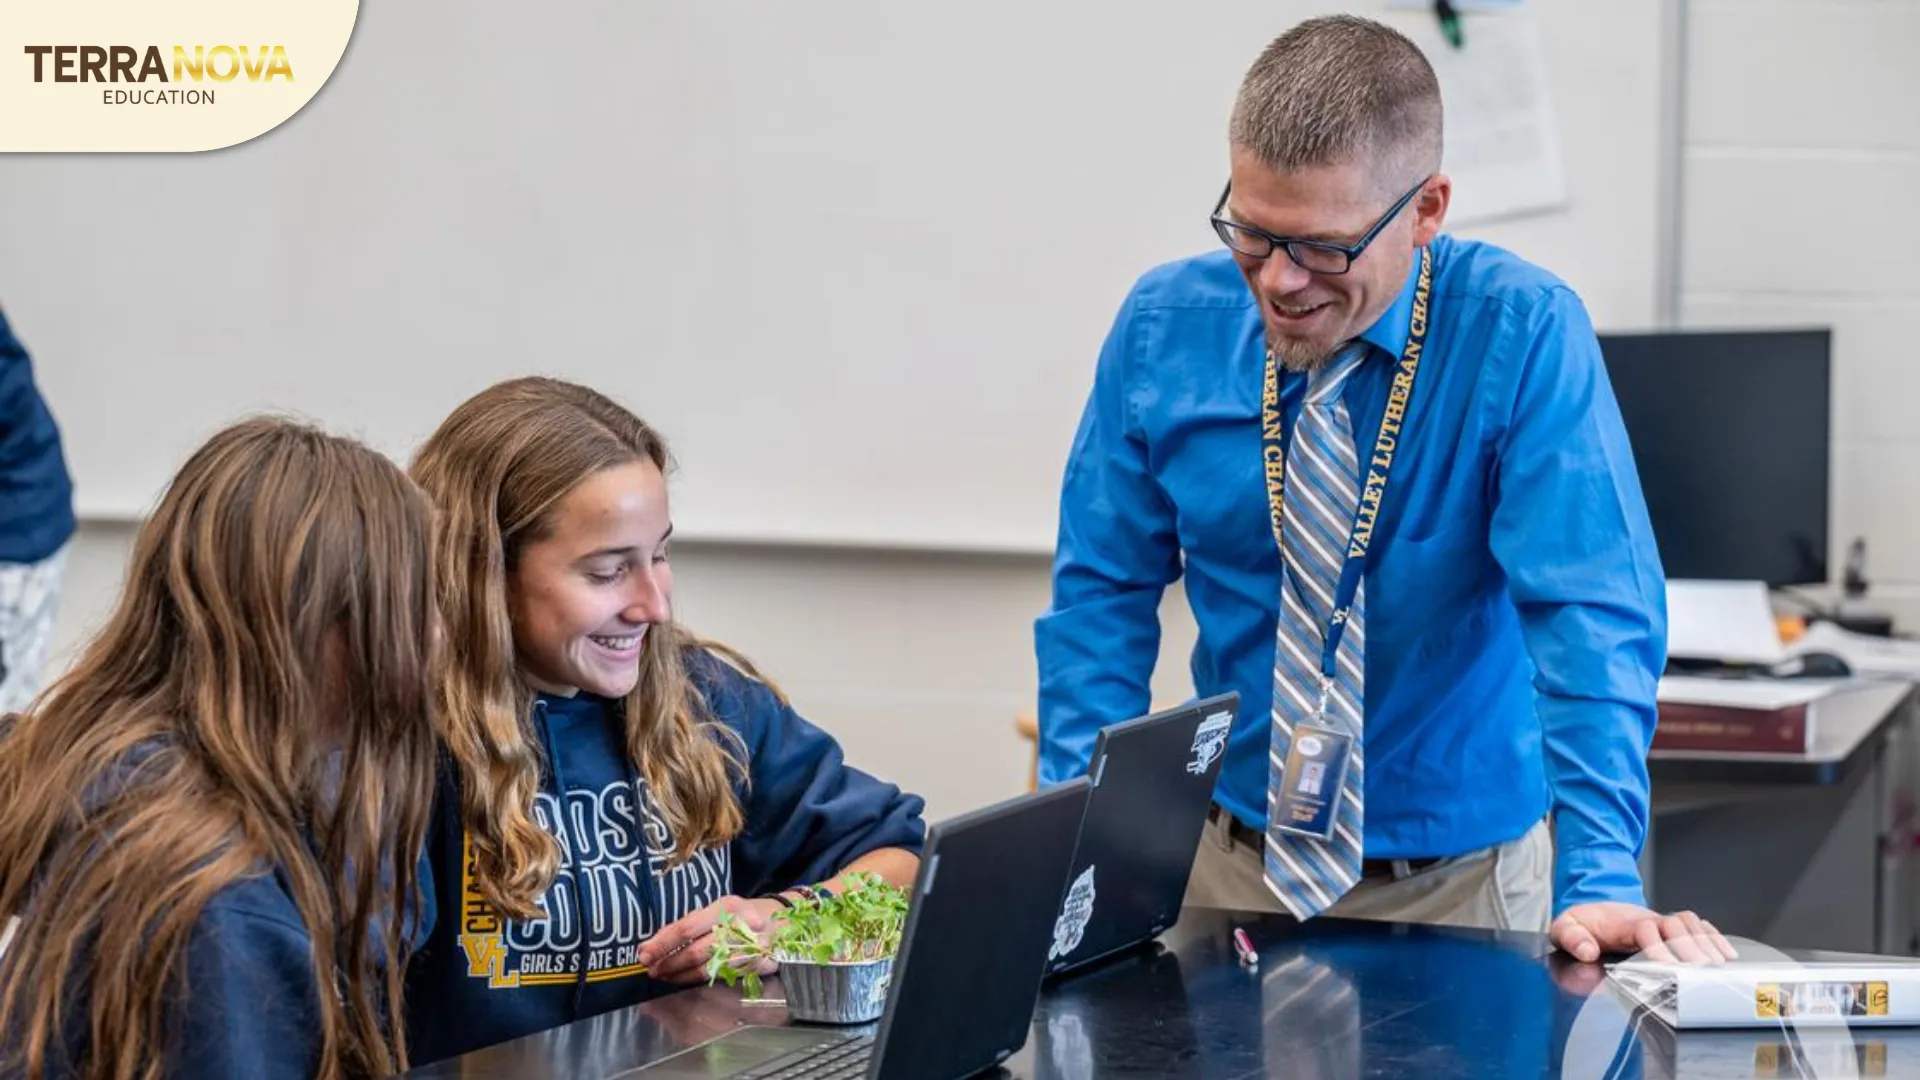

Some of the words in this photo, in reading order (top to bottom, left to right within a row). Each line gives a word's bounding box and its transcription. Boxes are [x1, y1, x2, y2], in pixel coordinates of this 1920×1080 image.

[1263, 350, 1281, 439] HERAN
[1347, 469, 1387, 558] VALLEY
[1371, 338, 1423, 469] LUTHERAN
[457, 934, 520, 989] VL
[520, 953, 565, 973] GIRLS
[569, 949, 613, 973] SATE
